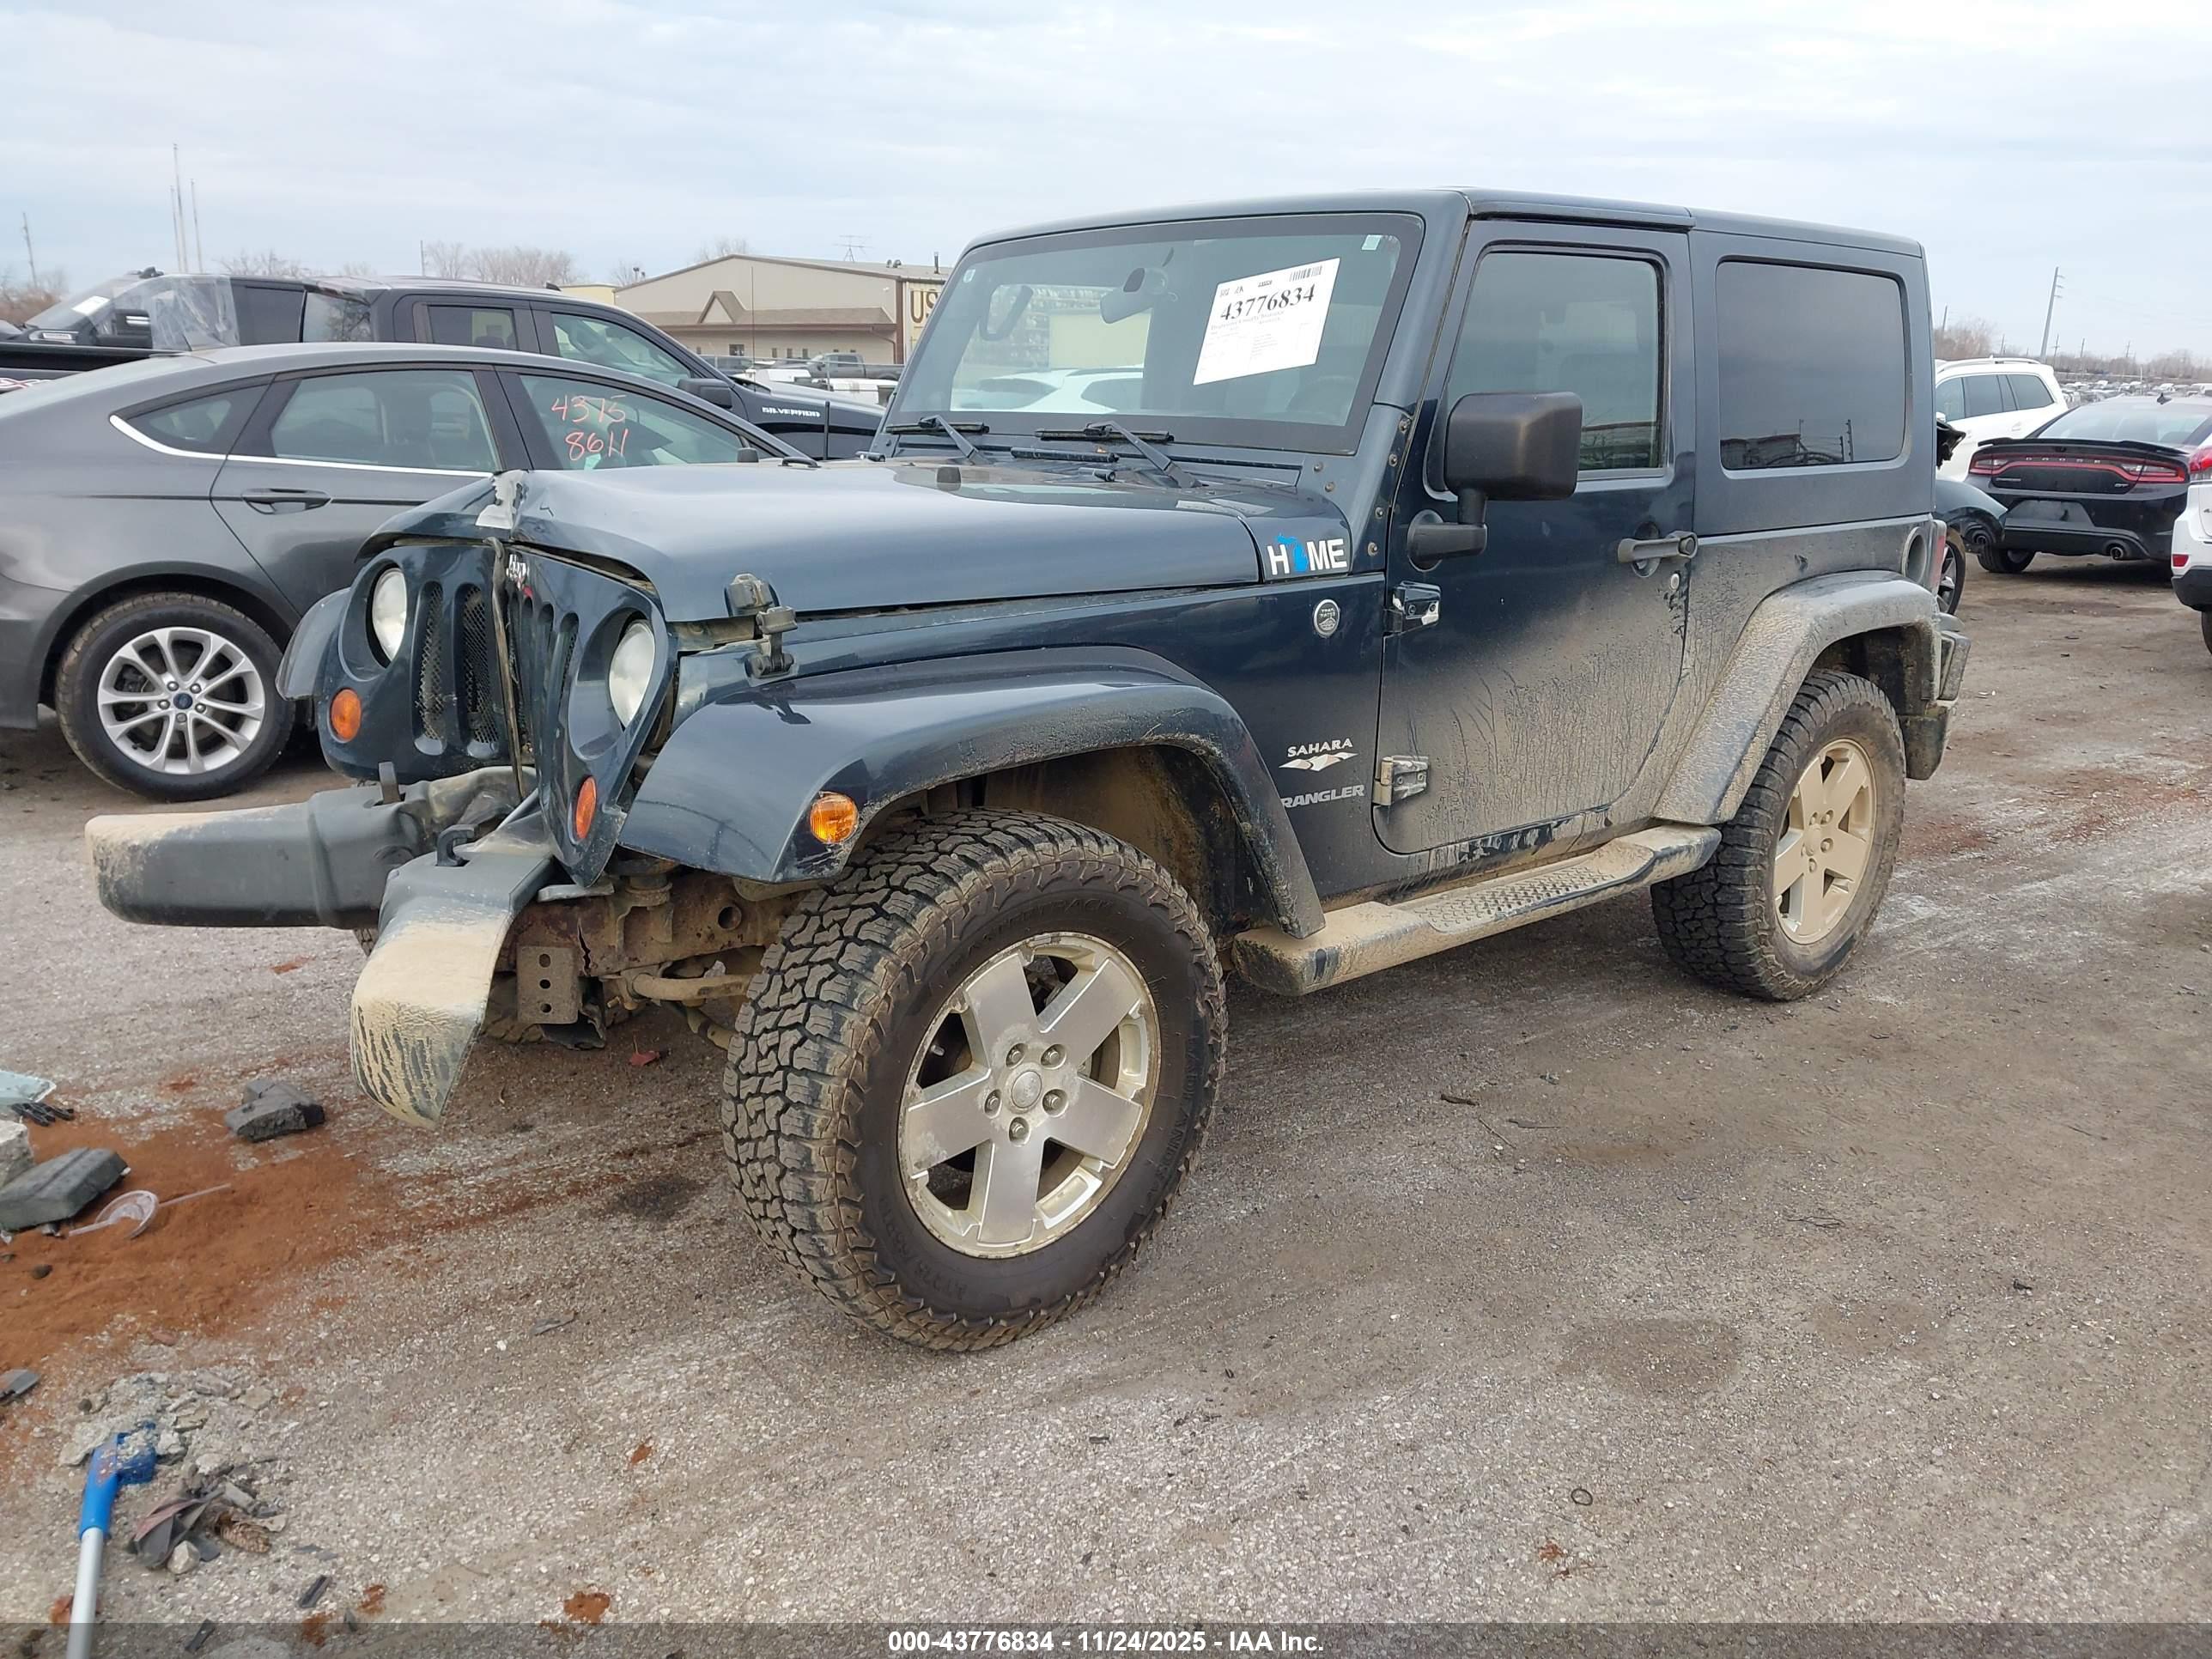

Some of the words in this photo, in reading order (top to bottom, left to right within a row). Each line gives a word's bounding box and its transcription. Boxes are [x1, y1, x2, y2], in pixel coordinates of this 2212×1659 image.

[1220, 284, 1316, 320] 43776834
[551, 394, 626, 422] 4375
[1287, 738, 1353, 757] SAHARA
[1279, 784, 1365, 808] RANGLER
